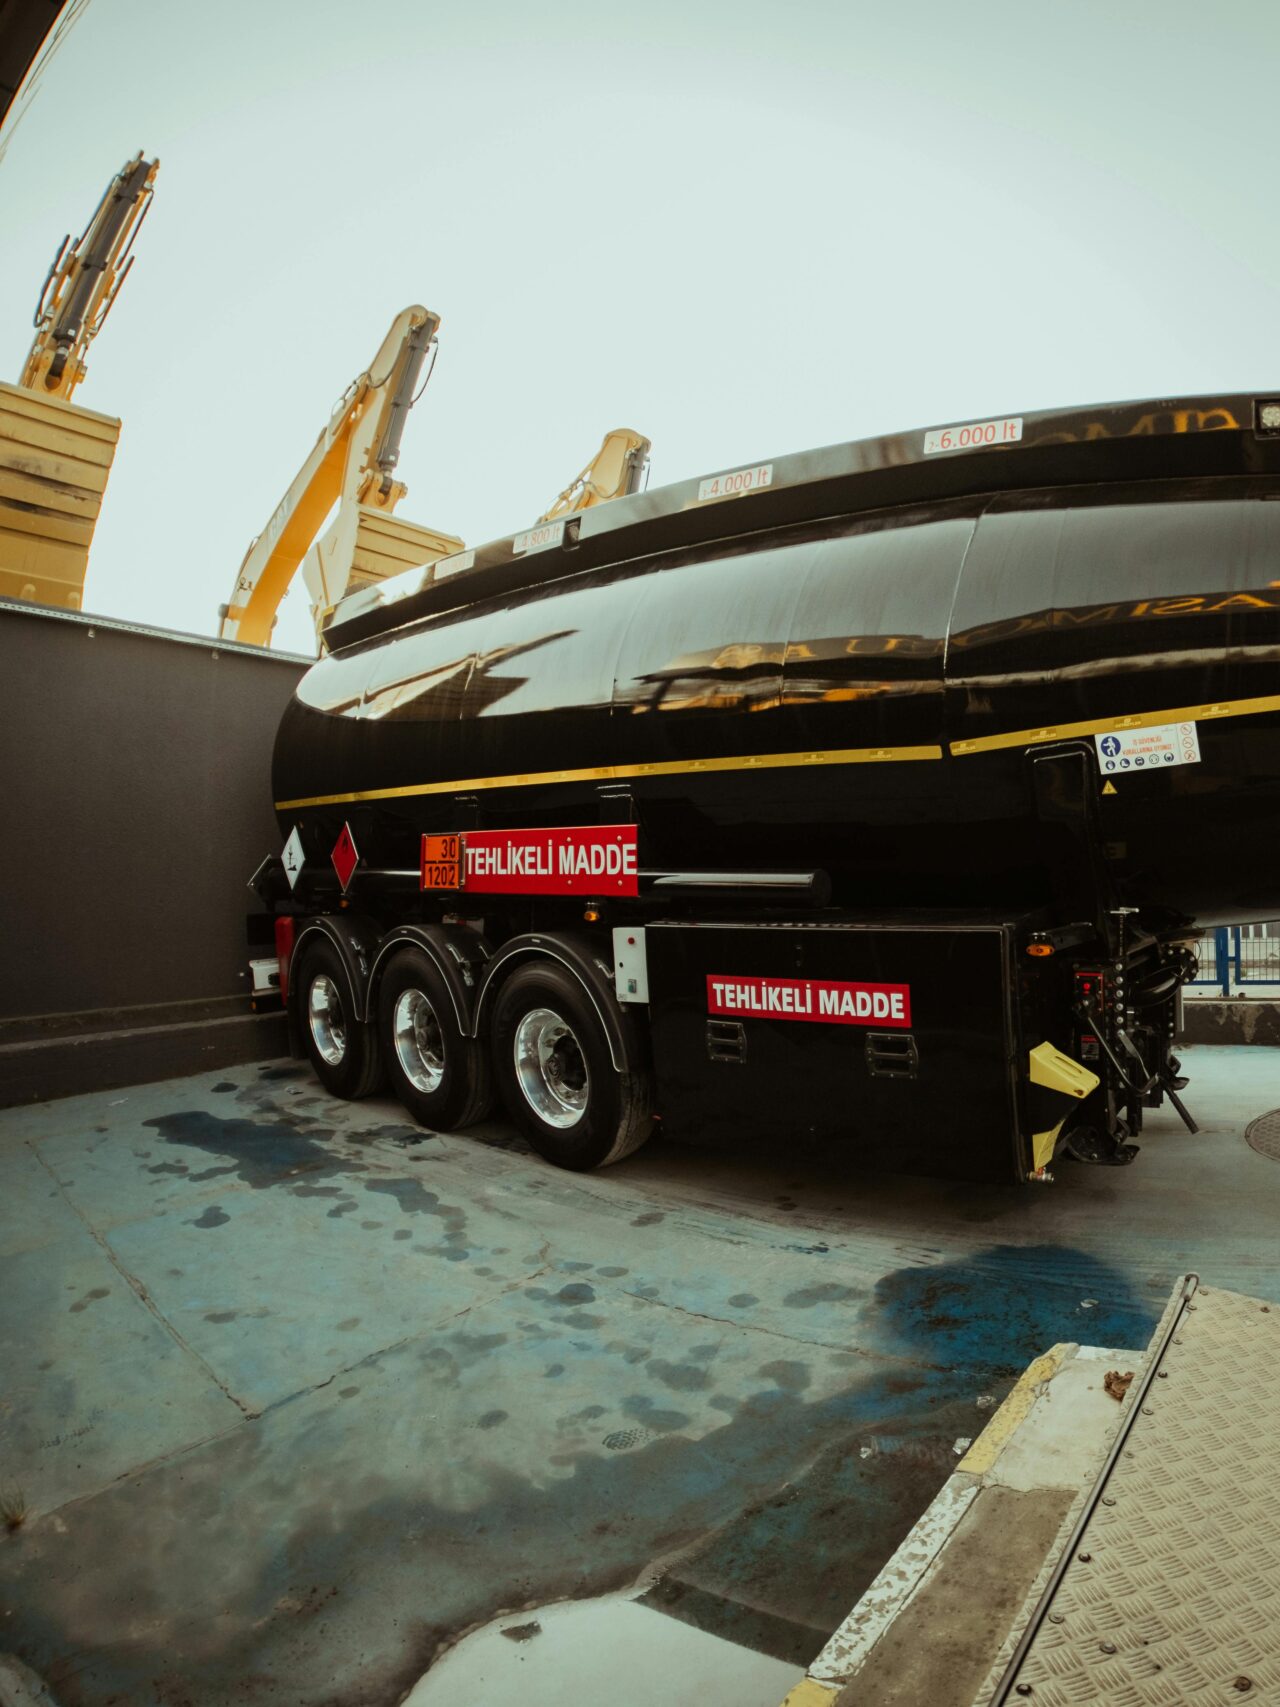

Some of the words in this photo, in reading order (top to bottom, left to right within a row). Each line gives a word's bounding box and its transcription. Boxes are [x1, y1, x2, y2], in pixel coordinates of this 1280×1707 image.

[441, 838, 456, 859] 30
[558, 843, 637, 875] MADDE
[427, 865, 456, 886] 1202
[818, 988, 905, 1019] MADDE
